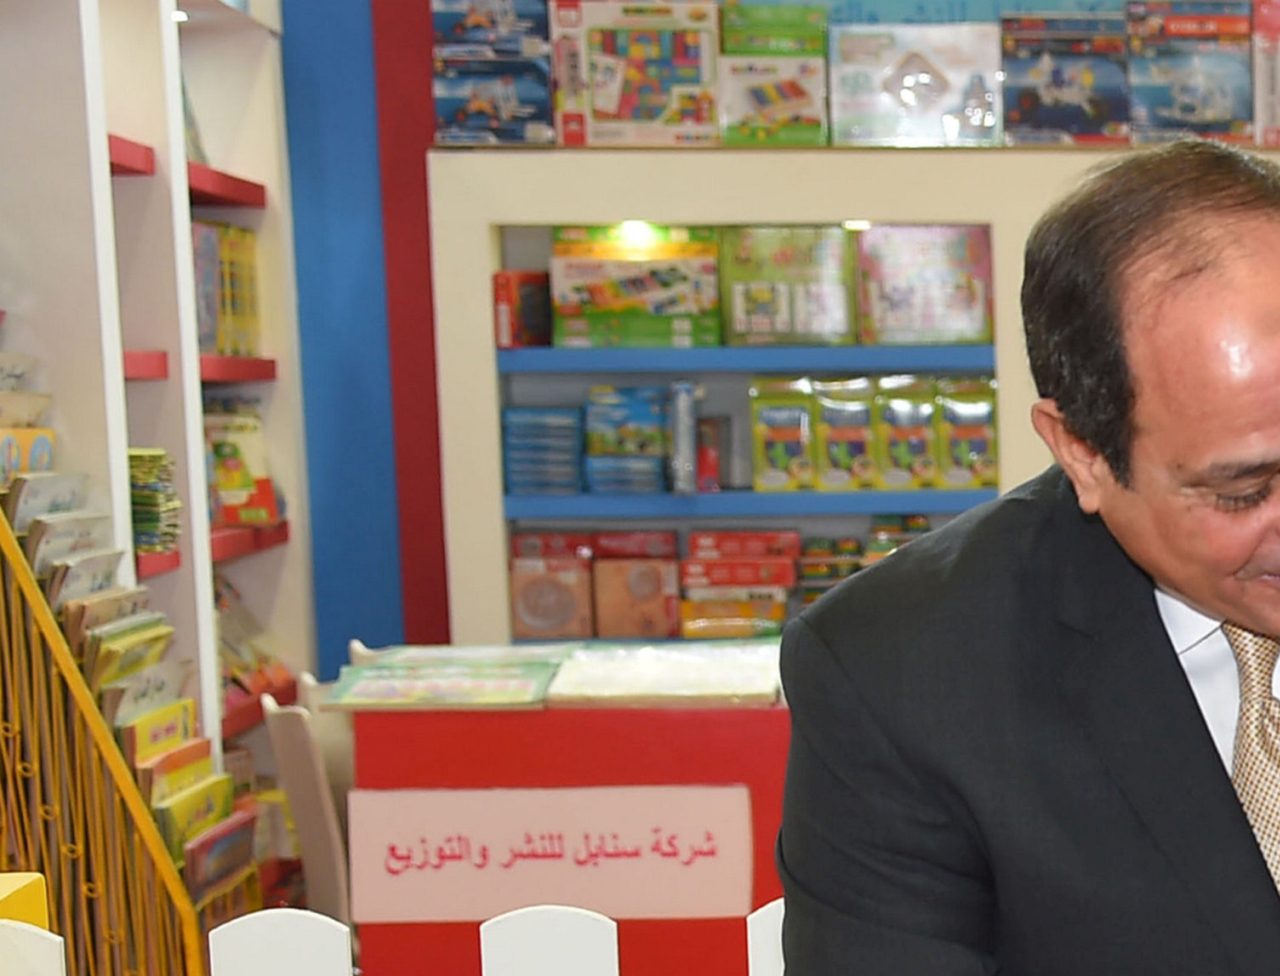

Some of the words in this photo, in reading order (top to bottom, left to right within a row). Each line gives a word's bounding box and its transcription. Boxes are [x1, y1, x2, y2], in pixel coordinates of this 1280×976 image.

[384, 834, 489, 875] والتوزيع
[500, 831, 565, 868] للنشر
[573, 832, 642, 866] سنابل
[651, 828, 718, 866] شركة
